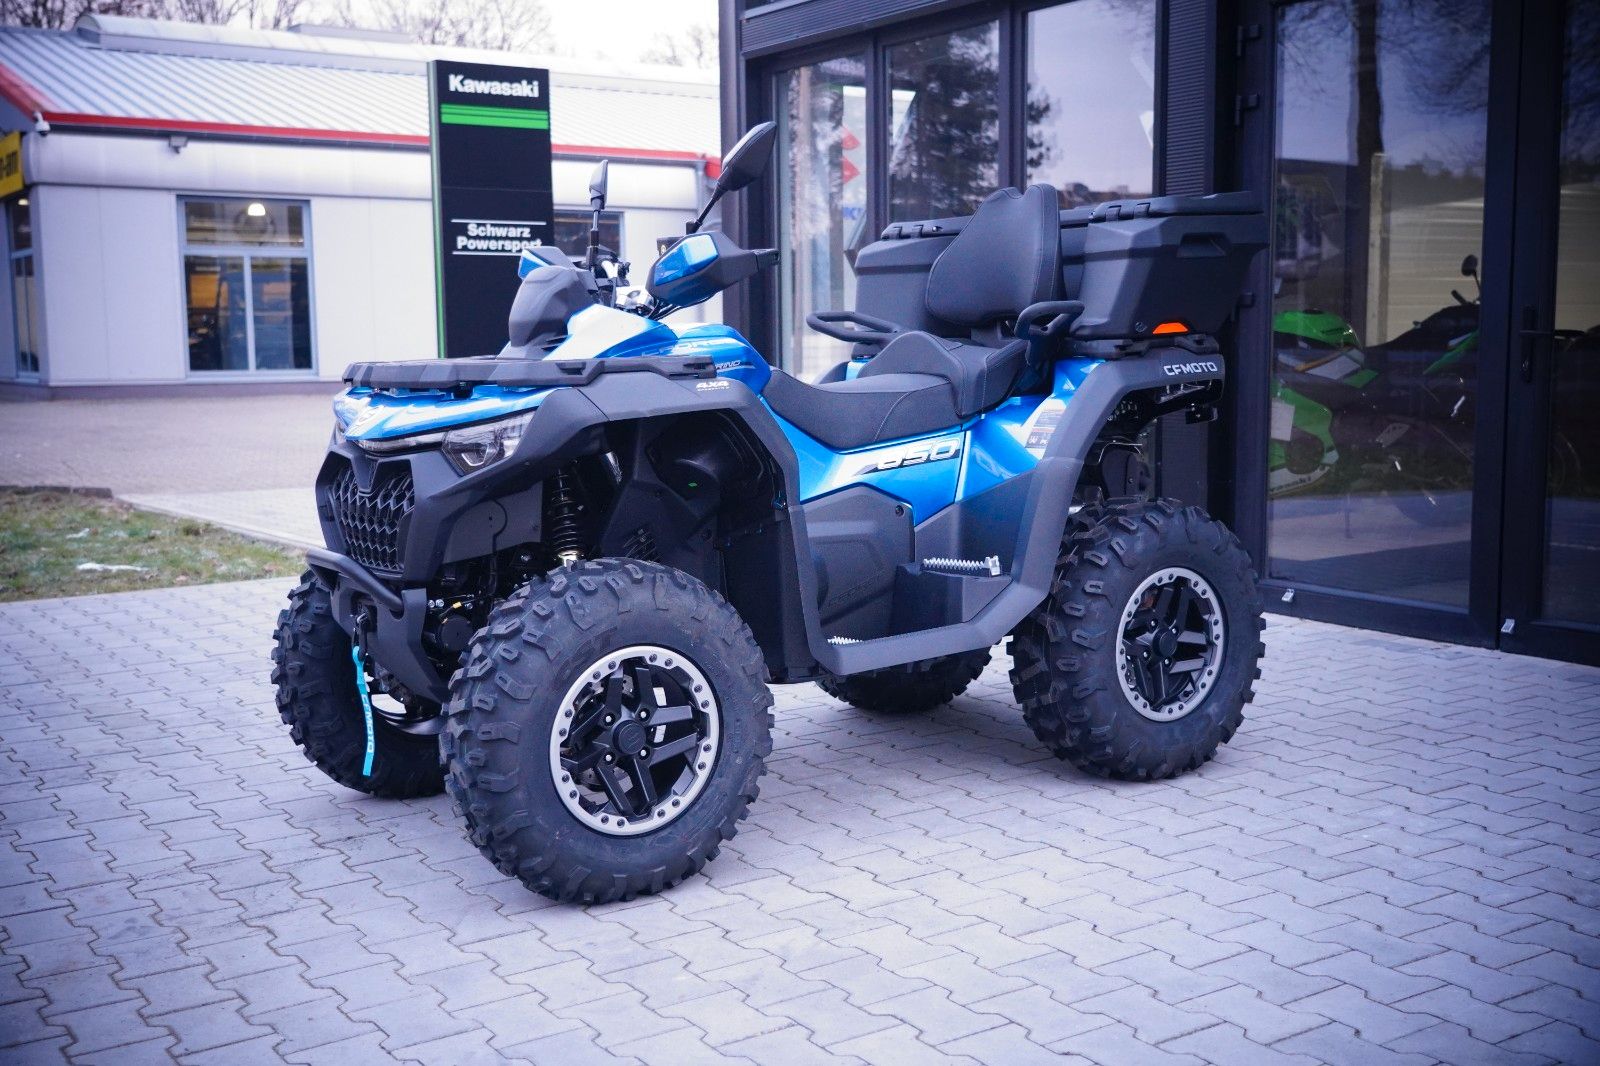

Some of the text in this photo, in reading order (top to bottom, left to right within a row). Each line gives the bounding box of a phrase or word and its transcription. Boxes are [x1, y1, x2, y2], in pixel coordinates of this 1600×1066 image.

[448, 73, 540, 98] Kawasaki
[466, 223, 531, 238] Schwarz
[456, 236, 542, 253] Powersport
[1163, 361, 1218, 376] CFMOTO
